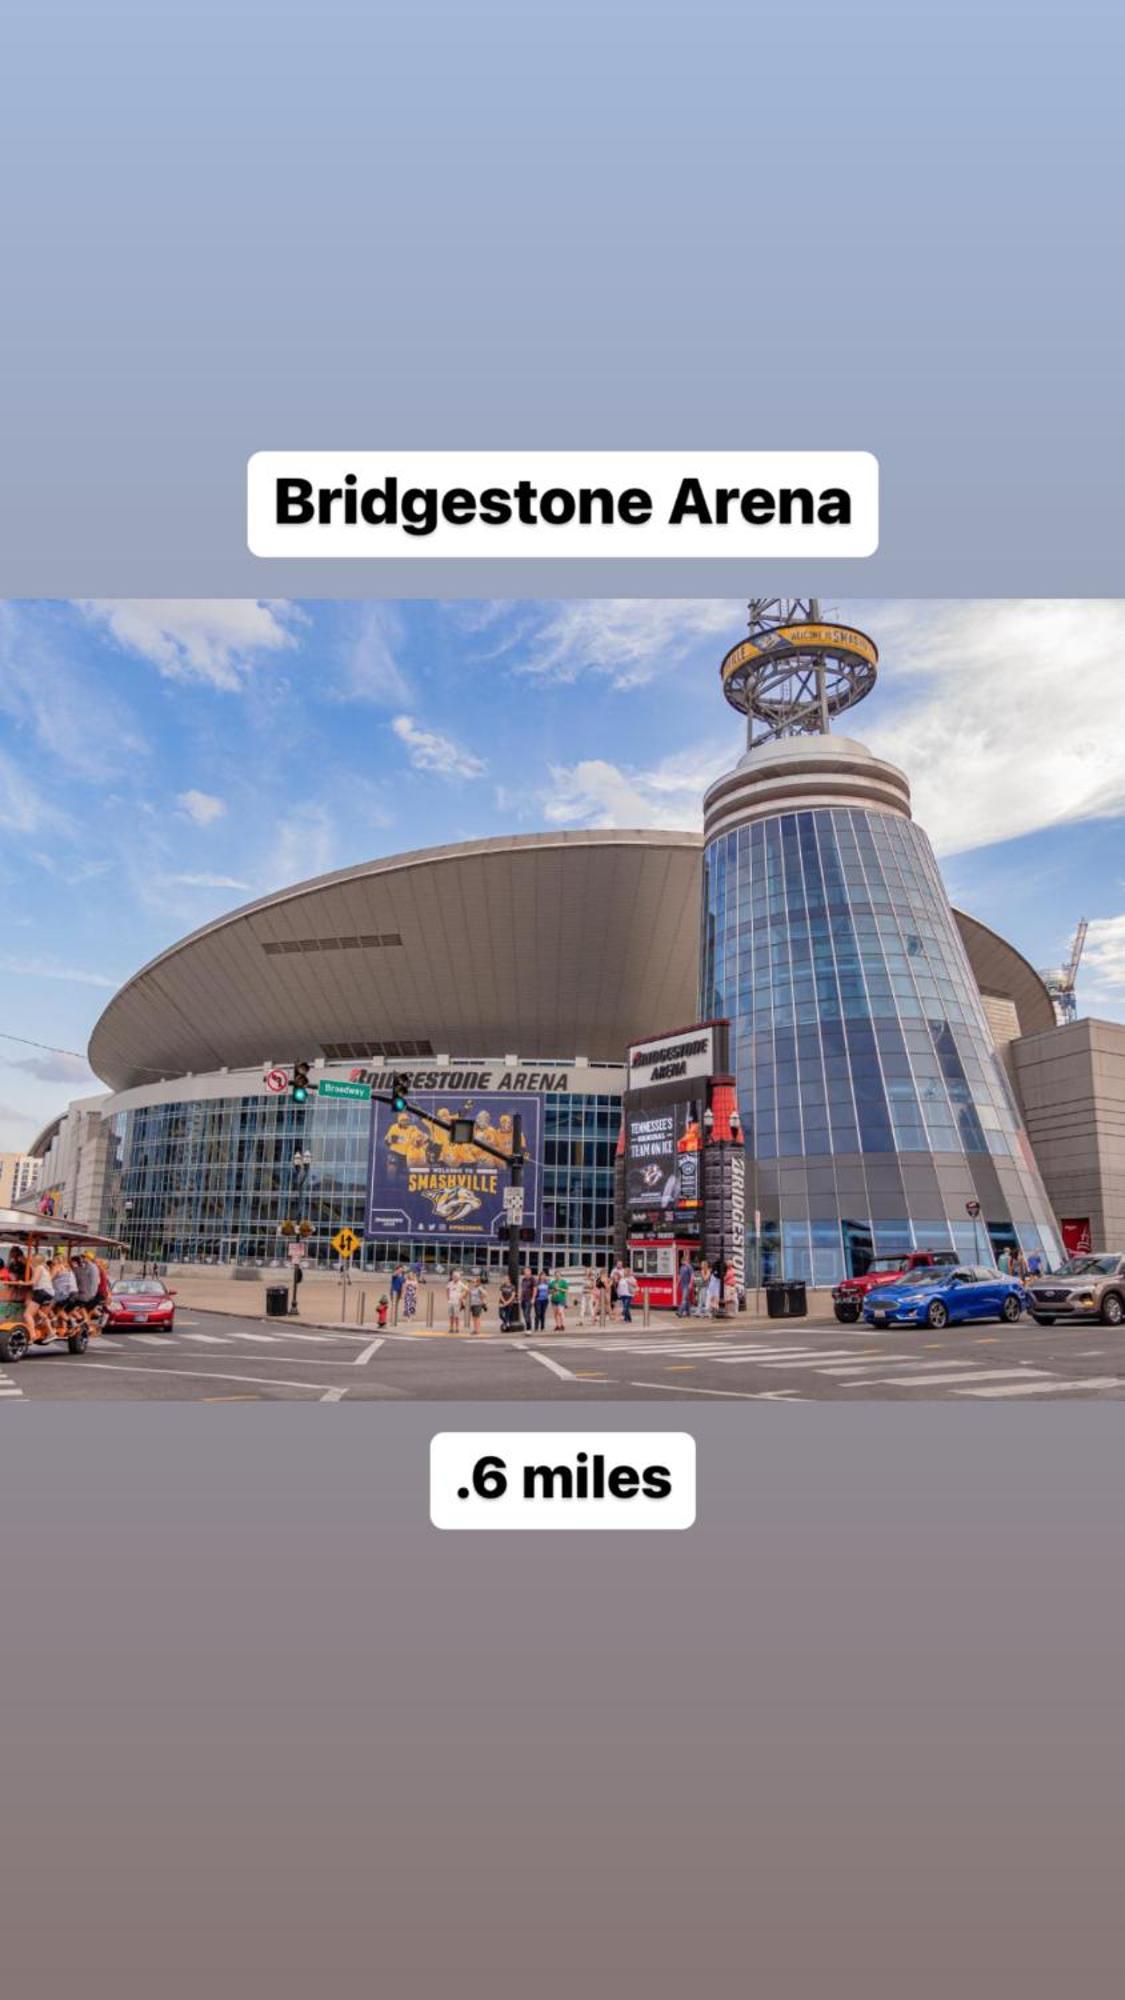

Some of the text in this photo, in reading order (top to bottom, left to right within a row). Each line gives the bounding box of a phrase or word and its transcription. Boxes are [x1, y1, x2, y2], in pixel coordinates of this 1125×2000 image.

[632, 1038, 709, 1068] BRIDGESTONE
[650, 1060, 687, 1081] ARENA
[325, 1083, 365, 1097] Broadway
[499, 1073, 569, 1091] ARENA
[631, 1117, 673, 1134] TENNESSEE'S
[631, 1144, 650, 1158] TEAM
[662, 1140, 673, 1154] ICE
[408, 1174, 498, 1195] SMASHVILLE
